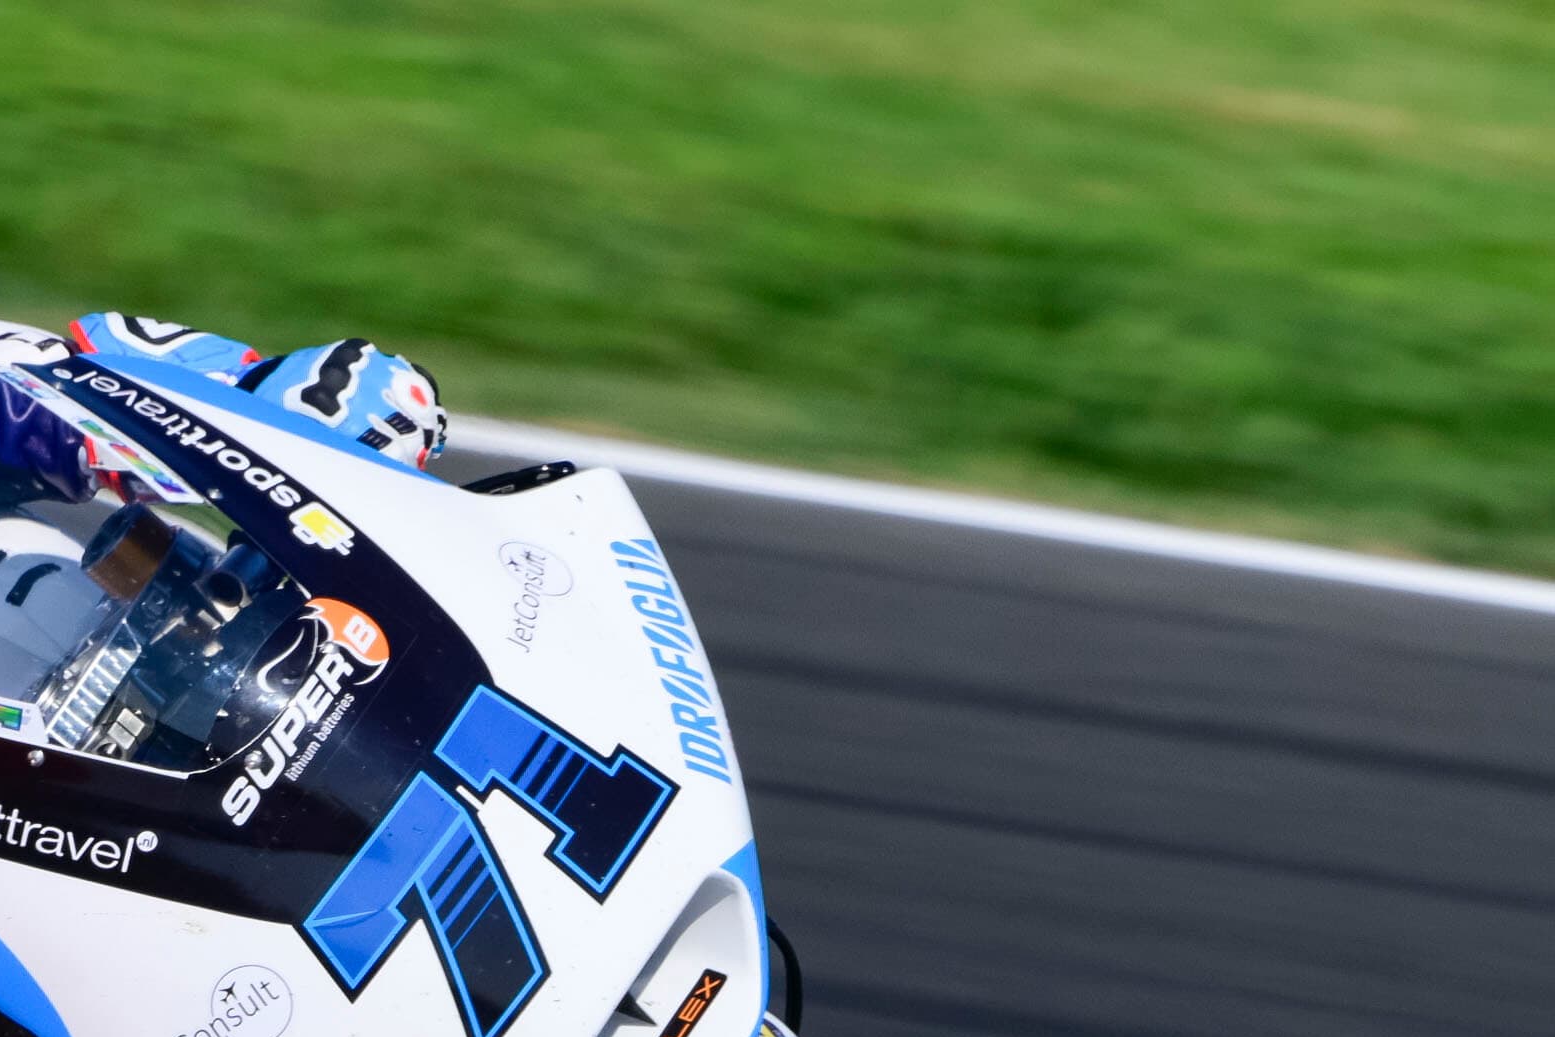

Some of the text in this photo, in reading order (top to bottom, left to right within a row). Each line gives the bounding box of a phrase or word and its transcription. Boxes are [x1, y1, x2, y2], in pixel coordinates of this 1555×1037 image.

[222, 652, 355, 827] SUPER
[284, 693, 355, 782] lithium batteries
